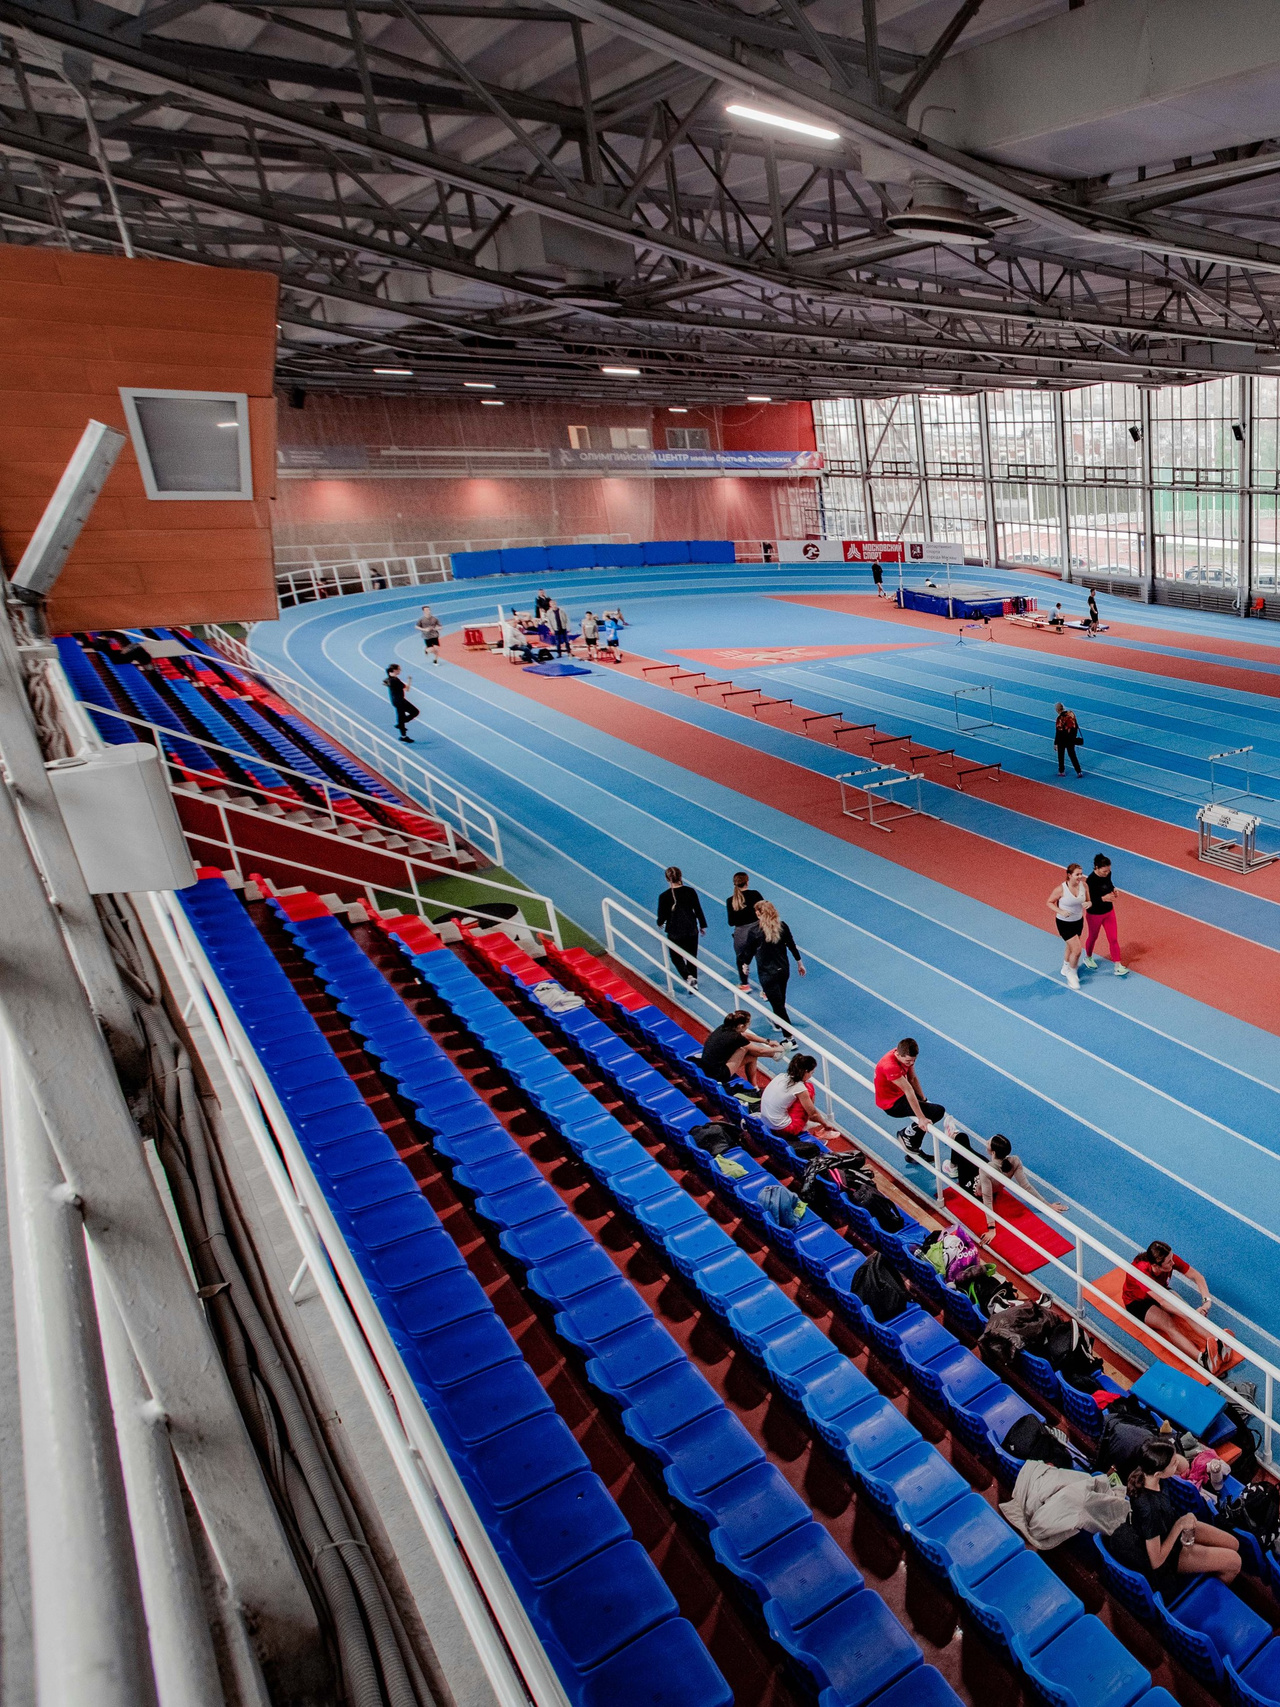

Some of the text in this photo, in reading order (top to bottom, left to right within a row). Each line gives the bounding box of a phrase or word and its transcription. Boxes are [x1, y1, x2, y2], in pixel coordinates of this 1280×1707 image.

[579, 451, 657, 461] ОЛИМПИЙСКИЙ
[658, 453, 689, 462] ЦЕНТР
[716, 454, 747, 463] братьев
[862, 543, 902, 552] МОСКОВСКИЙ
[862, 552, 882, 560] СПОРТ
